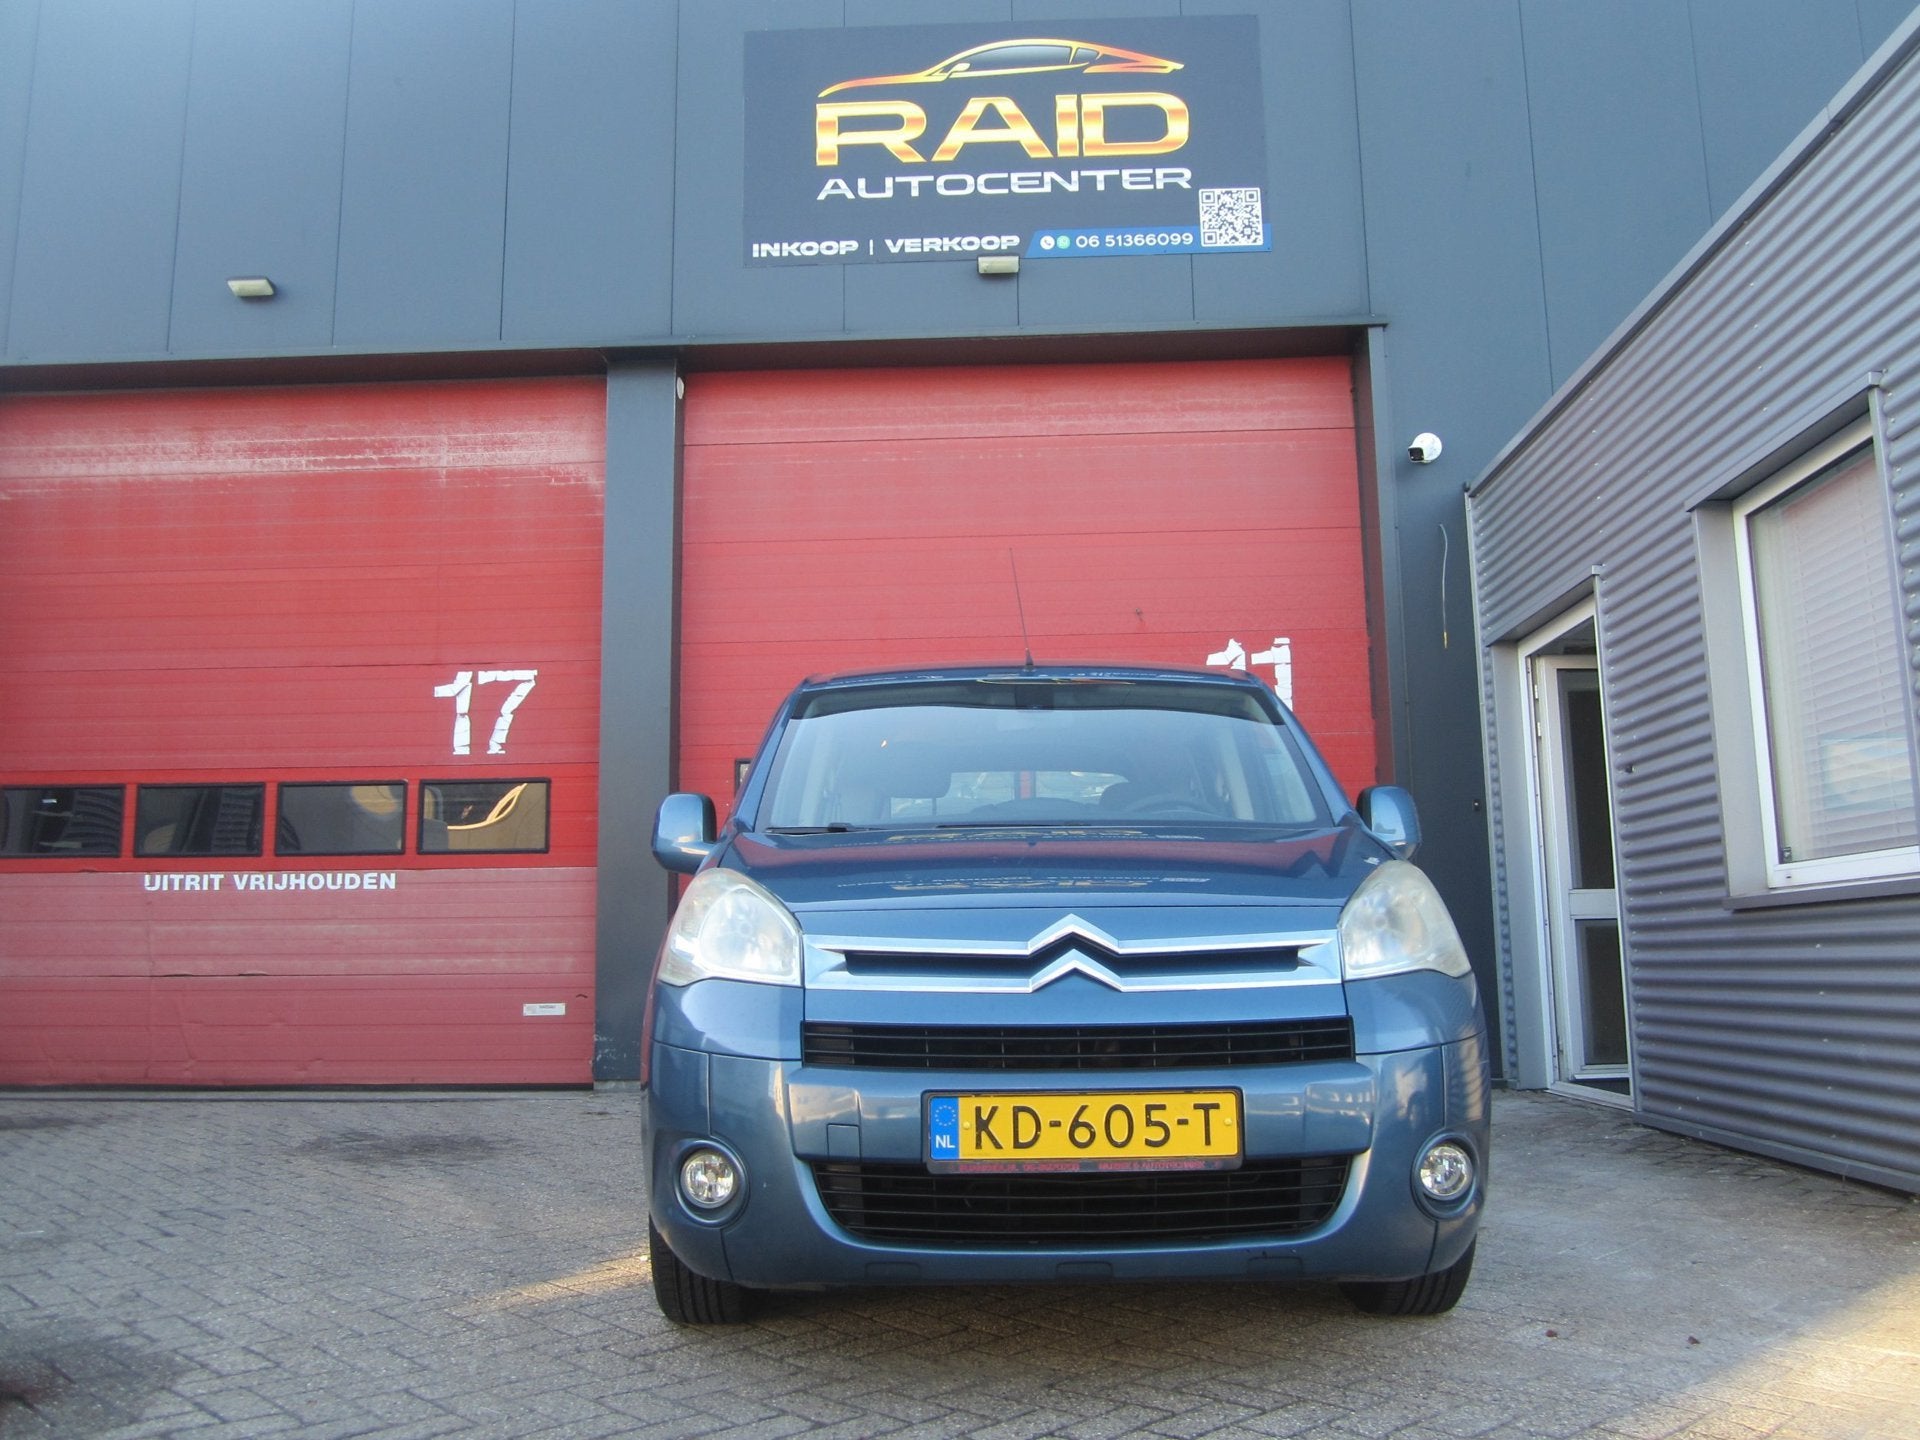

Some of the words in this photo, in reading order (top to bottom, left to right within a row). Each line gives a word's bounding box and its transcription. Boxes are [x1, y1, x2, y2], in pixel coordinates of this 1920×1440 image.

[815, 91, 1190, 166] RAID
[816, 167, 1193, 200] AUTOCENTER
[752, 240, 859, 258] INKOOP
[884, 235, 1020, 253] VERKOOP
[1075, 235, 1100, 248] 06
[1105, 232, 1194, 248] 51366099
[434, 669, 538, 755] 17
[144, 873, 224, 891] UITRIT
[233, 872, 396, 890] VRIJHOUDEN
[974, 1102, 1220, 1150] KD-605-T
[935, 1135, 955, 1149] NL
